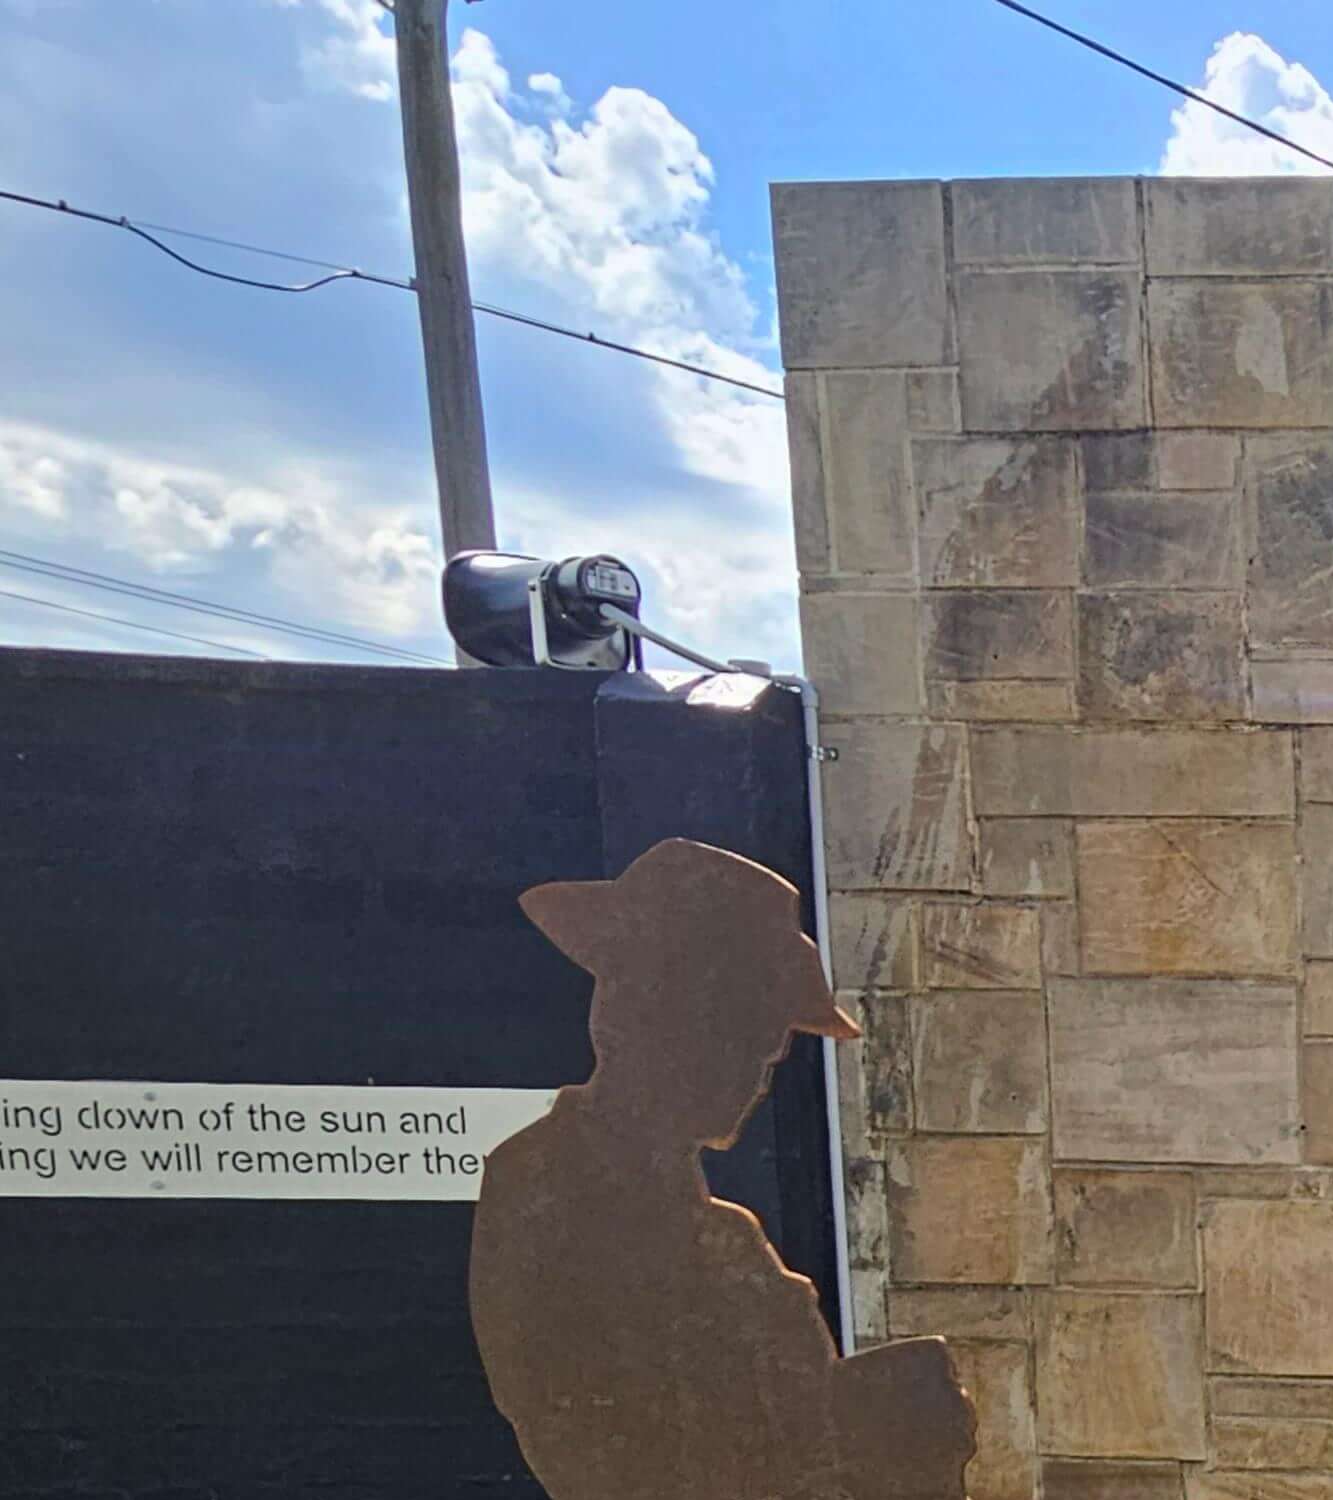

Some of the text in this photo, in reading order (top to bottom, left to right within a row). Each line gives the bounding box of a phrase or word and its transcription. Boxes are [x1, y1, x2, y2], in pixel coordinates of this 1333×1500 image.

[78, 1100, 184, 1130] down
[199, 1102, 235, 1131] of
[247, 1103, 306, 1132] the
[320, 1111, 386, 1133] sun
[400, 1105, 467, 1135] and
[69, 1149, 127, 1172] we
[141, 1143, 202, 1172] will
[217, 1145, 410, 1175] remember
[423, 1147, 486, 1175] the
